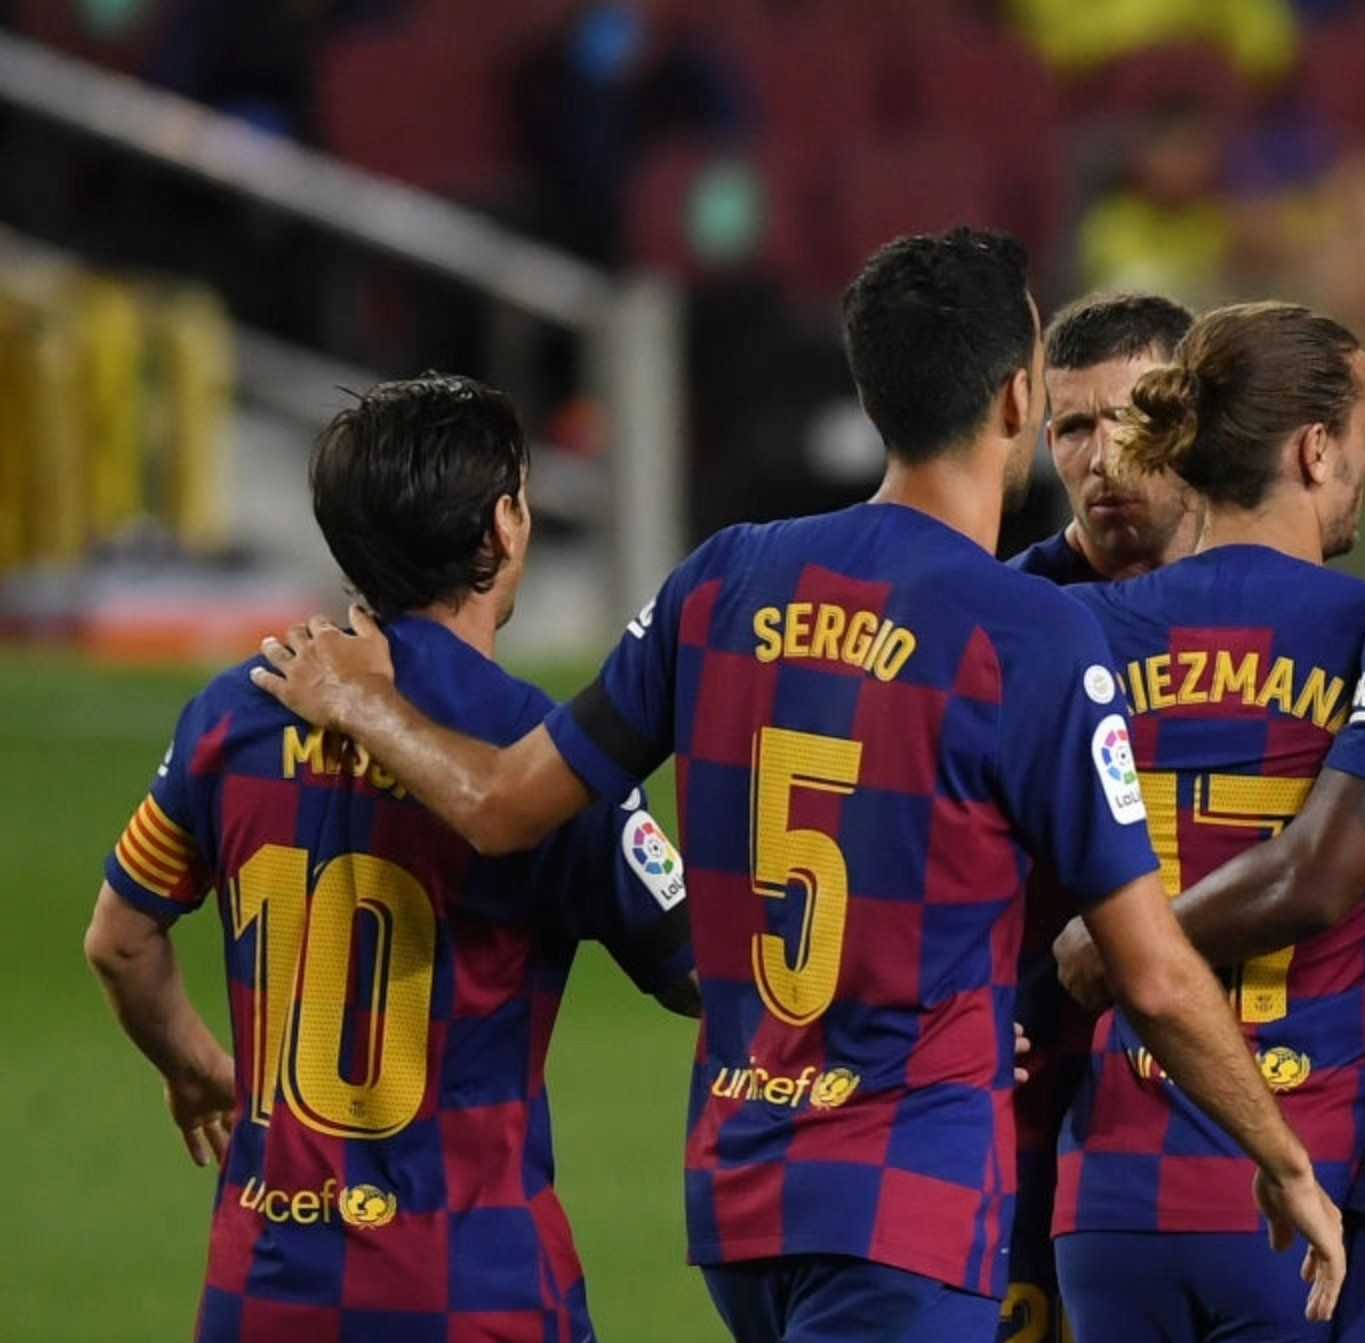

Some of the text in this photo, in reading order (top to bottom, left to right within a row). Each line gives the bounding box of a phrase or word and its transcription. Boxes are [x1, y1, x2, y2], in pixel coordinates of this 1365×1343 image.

[753, 603, 916, 682] SERGIO
[1116, 650, 1350, 735] IEZMAN
[750, 726, 863, 1027] 5
[230, 844, 437, 1141] 10
